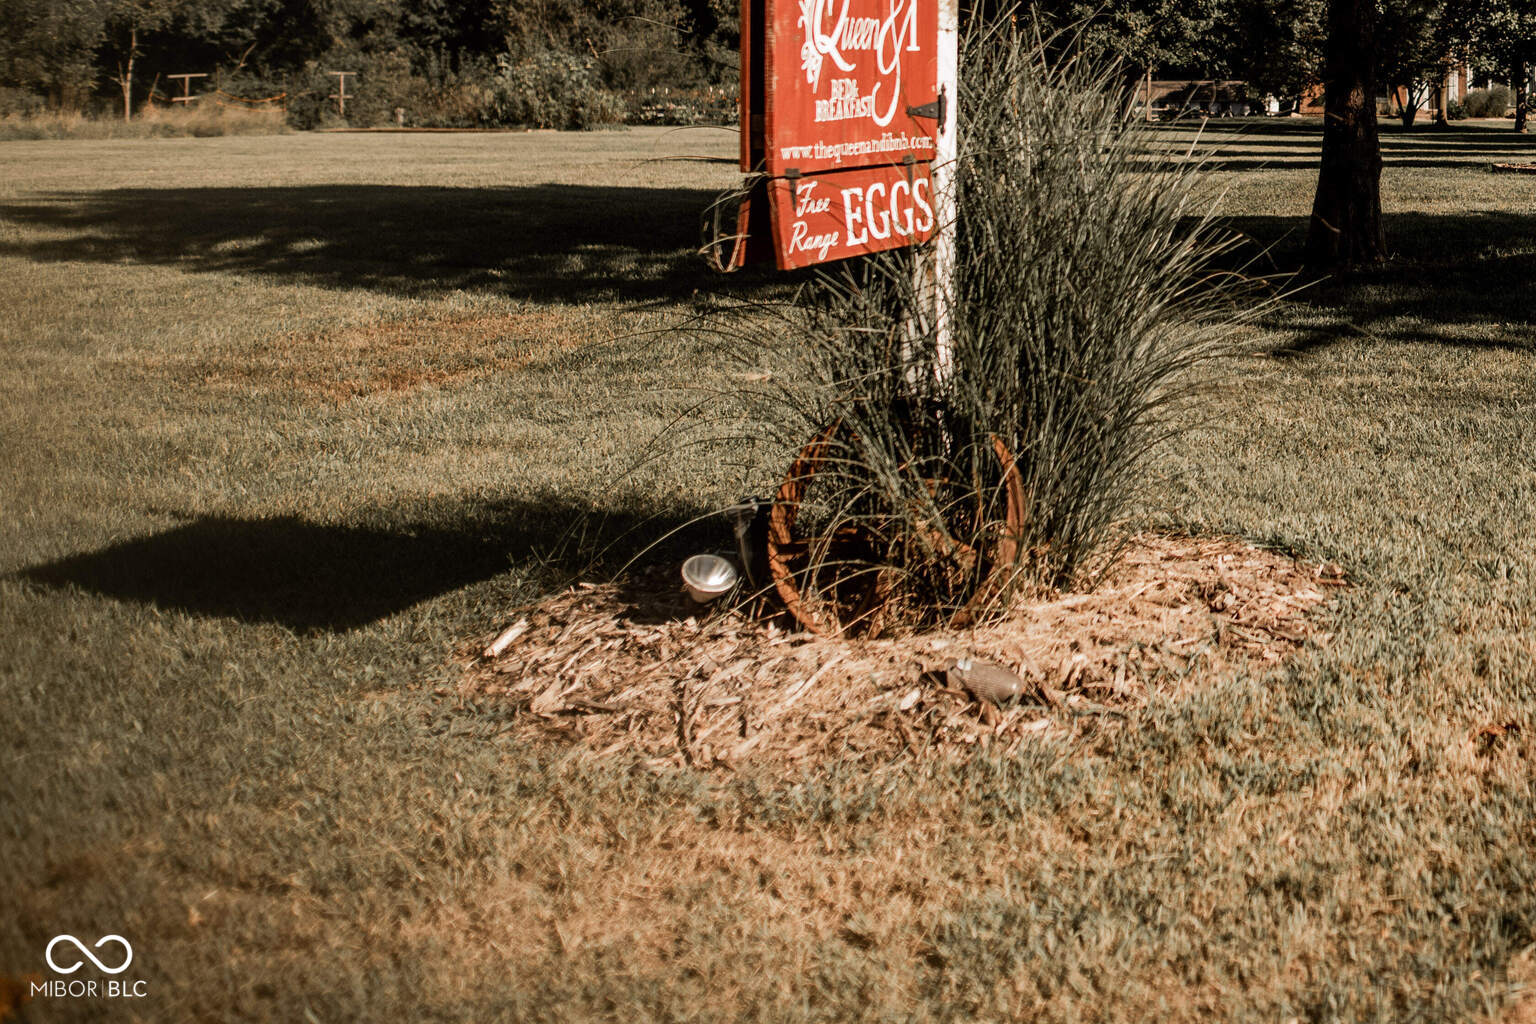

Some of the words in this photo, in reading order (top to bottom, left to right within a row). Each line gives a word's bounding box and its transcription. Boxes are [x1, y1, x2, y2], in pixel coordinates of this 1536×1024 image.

[814, 95, 873, 122] BREAKFAST
[796, 181, 831, 217] Free
[841, 178, 934, 246] EGGS
[789, 221, 839, 260] Range
